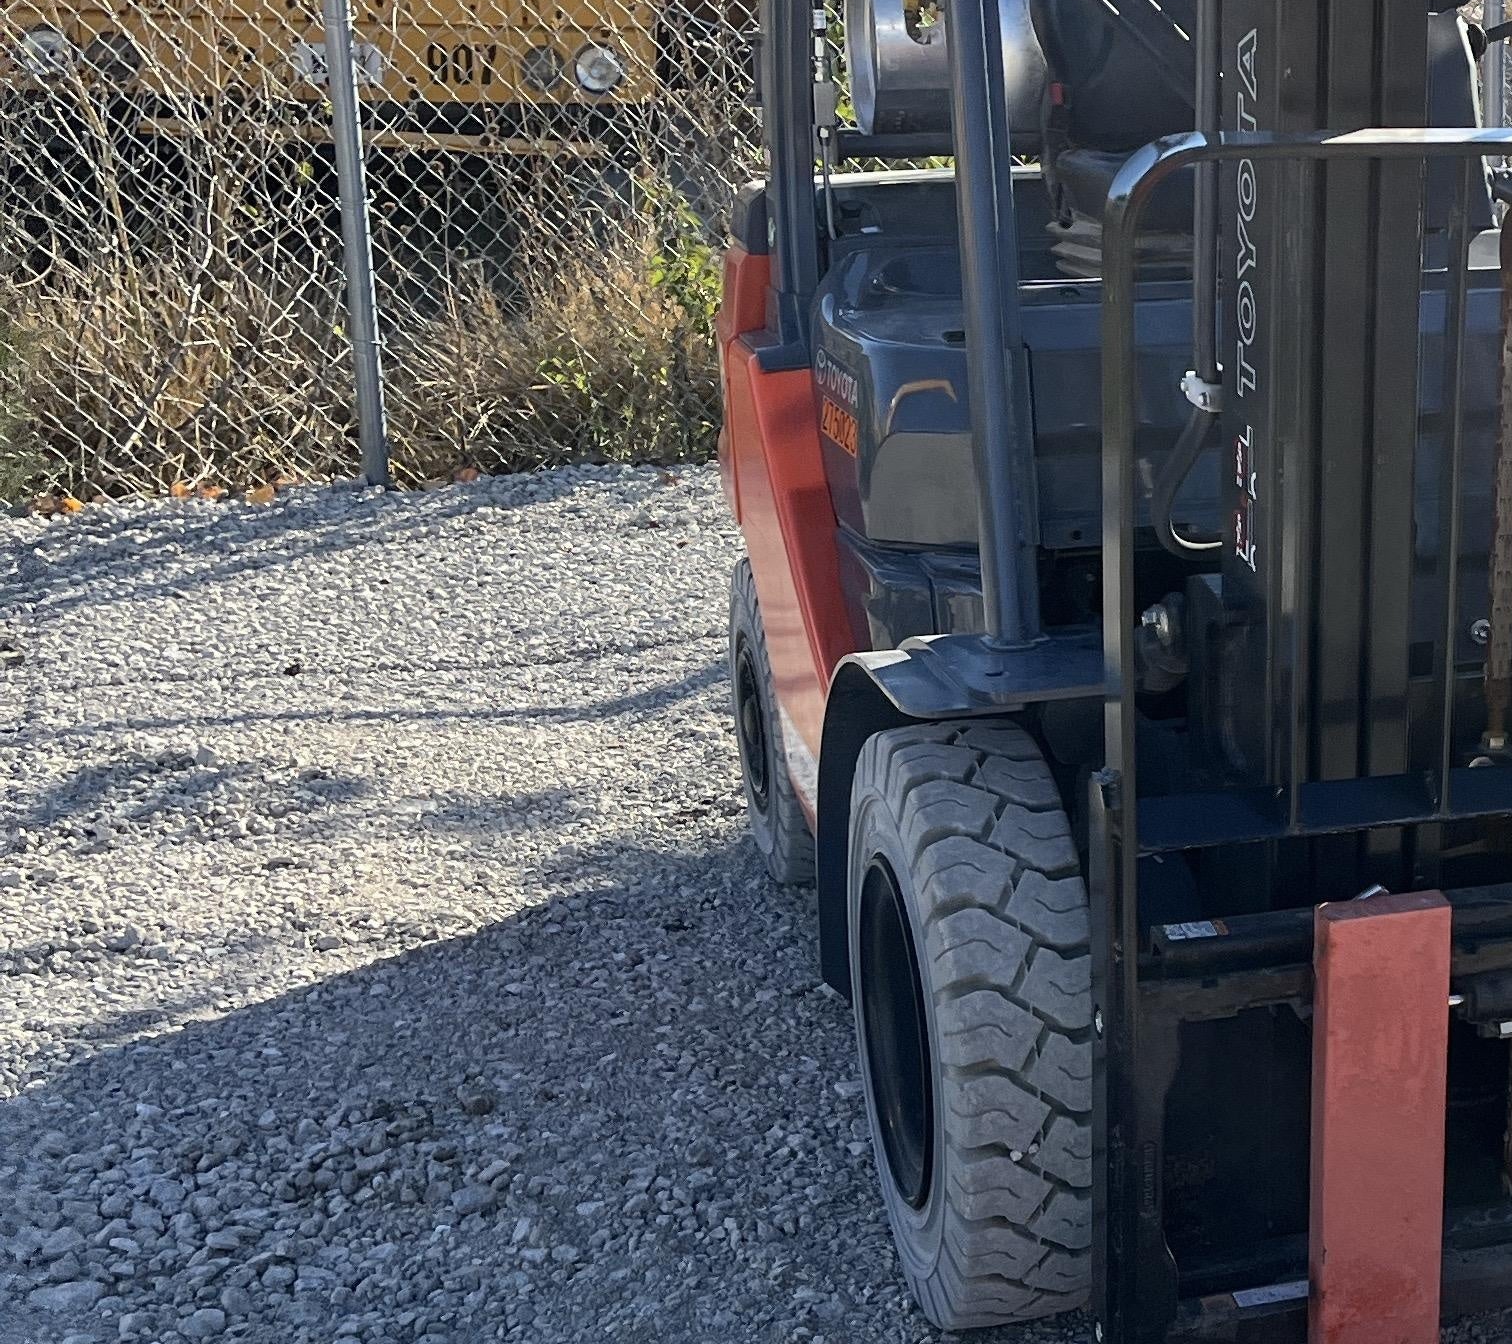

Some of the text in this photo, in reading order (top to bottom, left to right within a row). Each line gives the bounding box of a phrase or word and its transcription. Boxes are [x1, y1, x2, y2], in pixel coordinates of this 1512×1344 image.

[426, 42, 497, 86] 907
[1237, 28, 1258, 399] TOYOTA
[826, 361, 858, 409] TOYOTA
